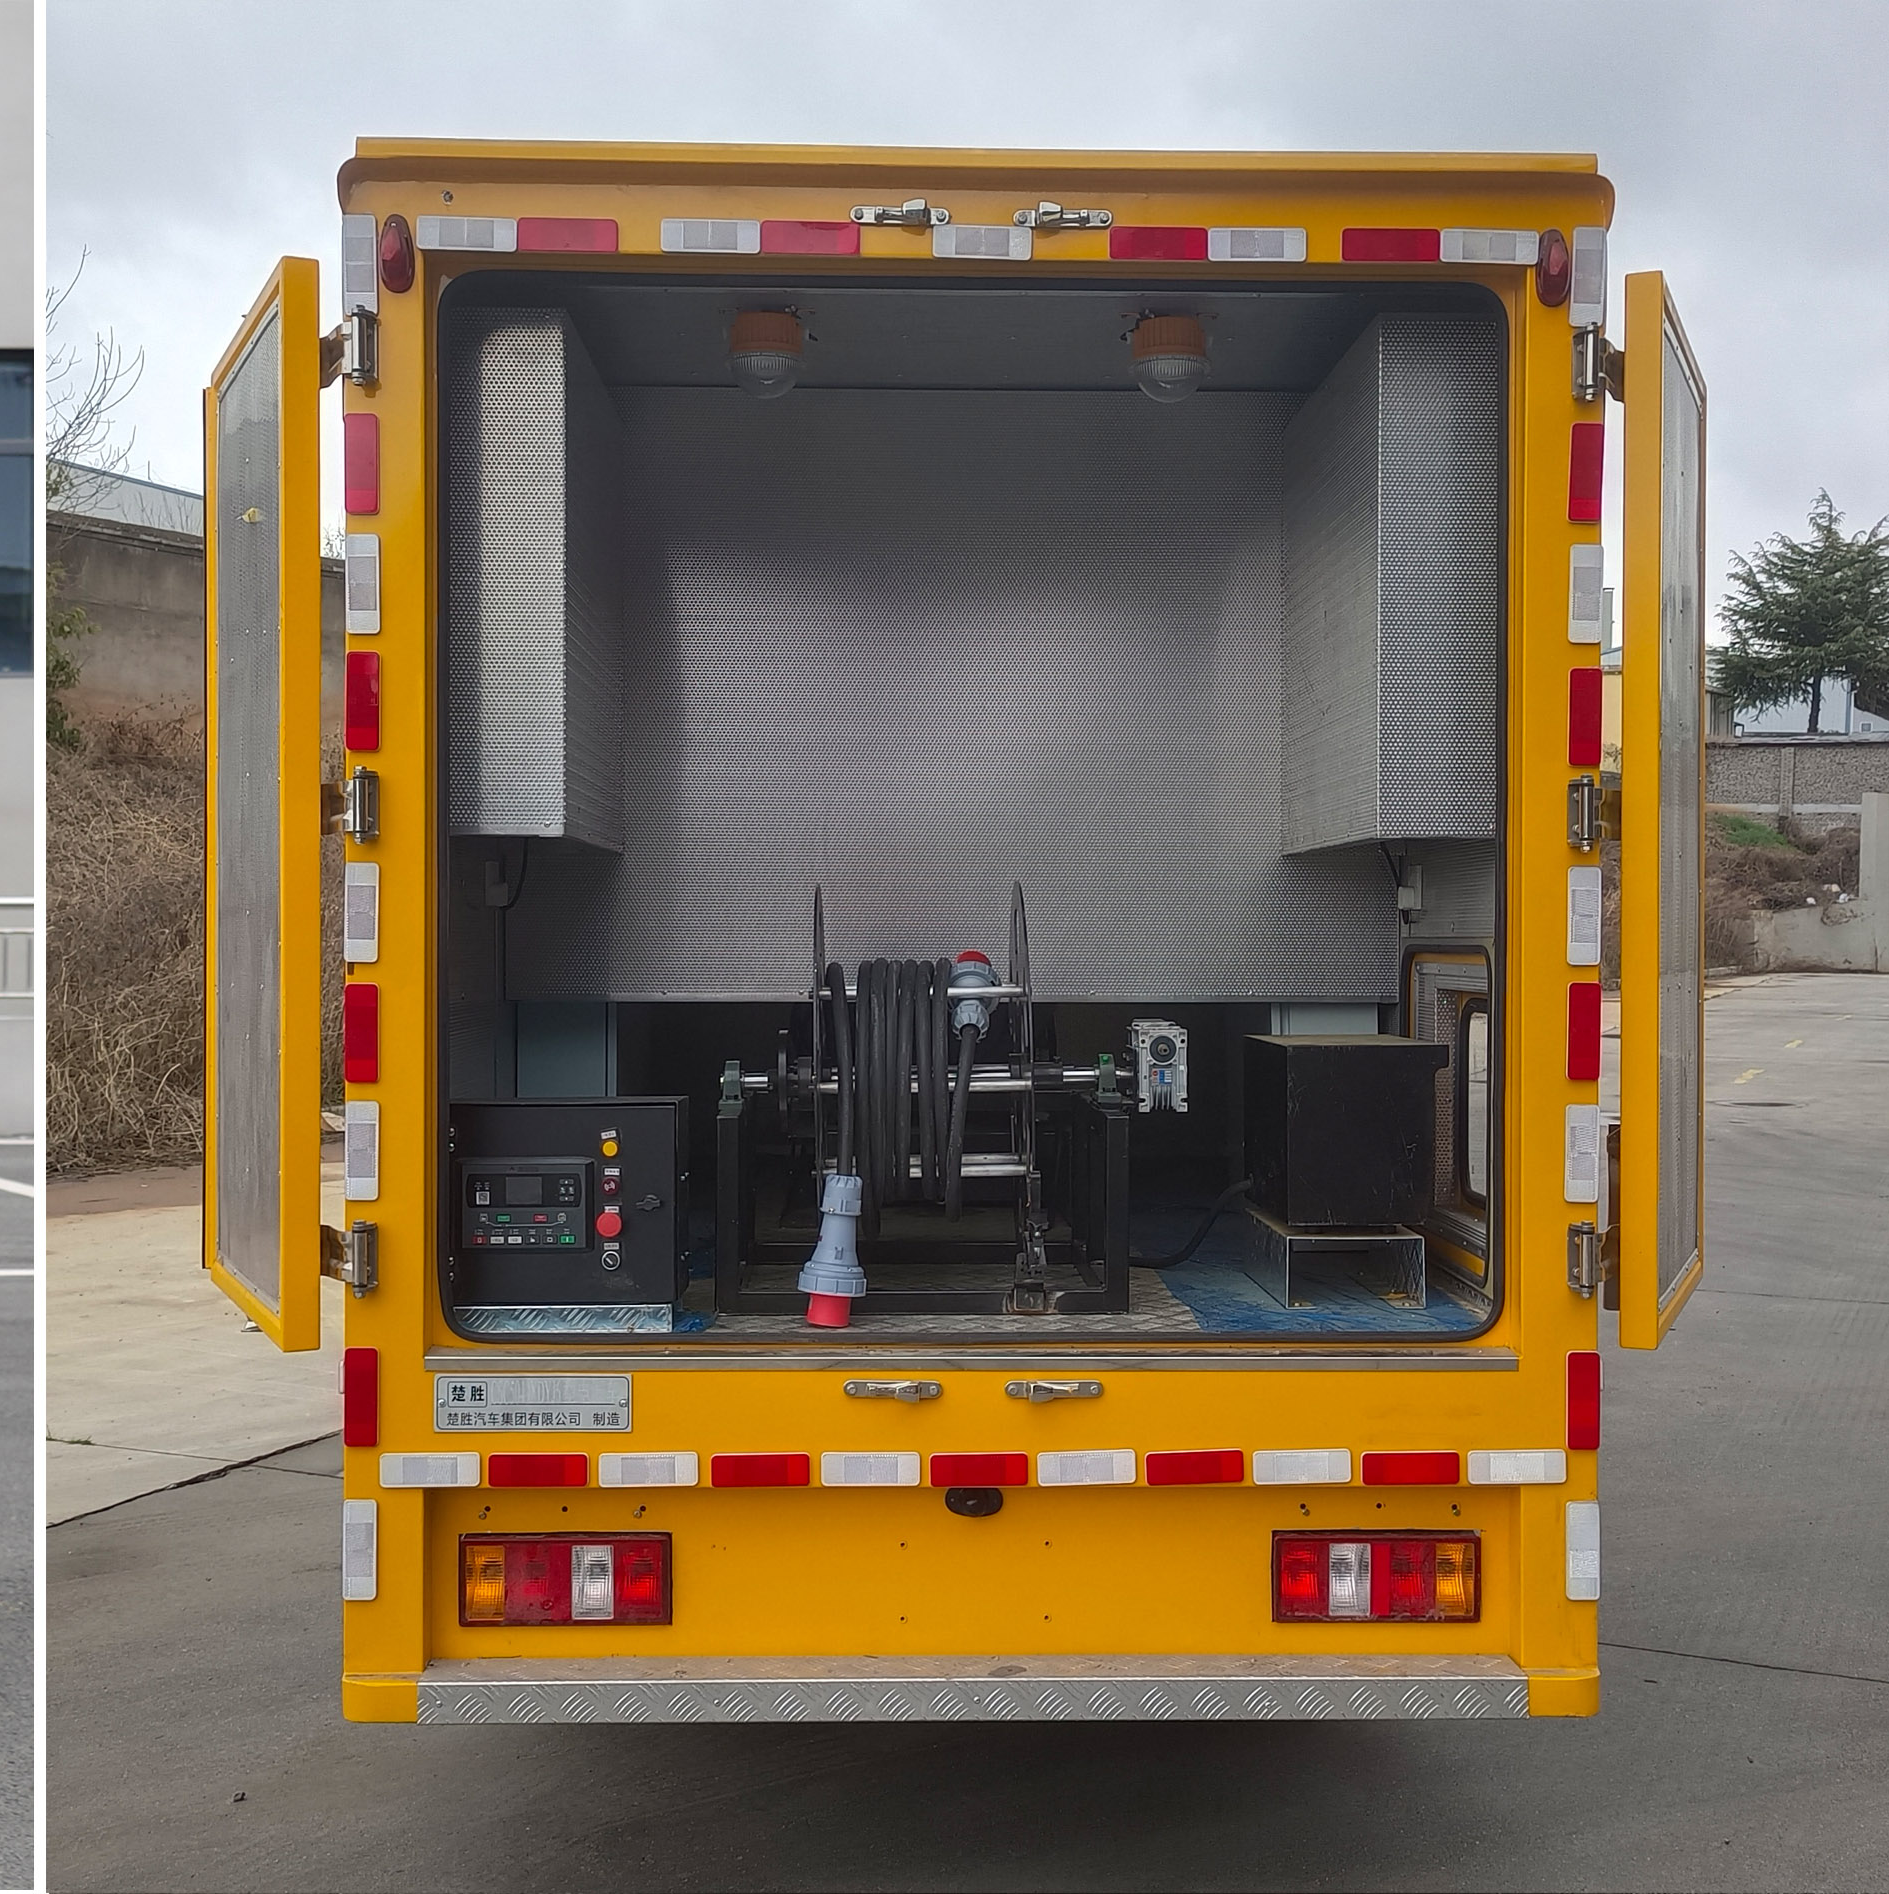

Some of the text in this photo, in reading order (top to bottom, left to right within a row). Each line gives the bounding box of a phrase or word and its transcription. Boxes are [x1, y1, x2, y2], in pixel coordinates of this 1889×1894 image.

[451, 1385, 485, 1402] 楚胜
[446, 1411, 621, 1427] 楚胜汽车集团有限公司 制造
